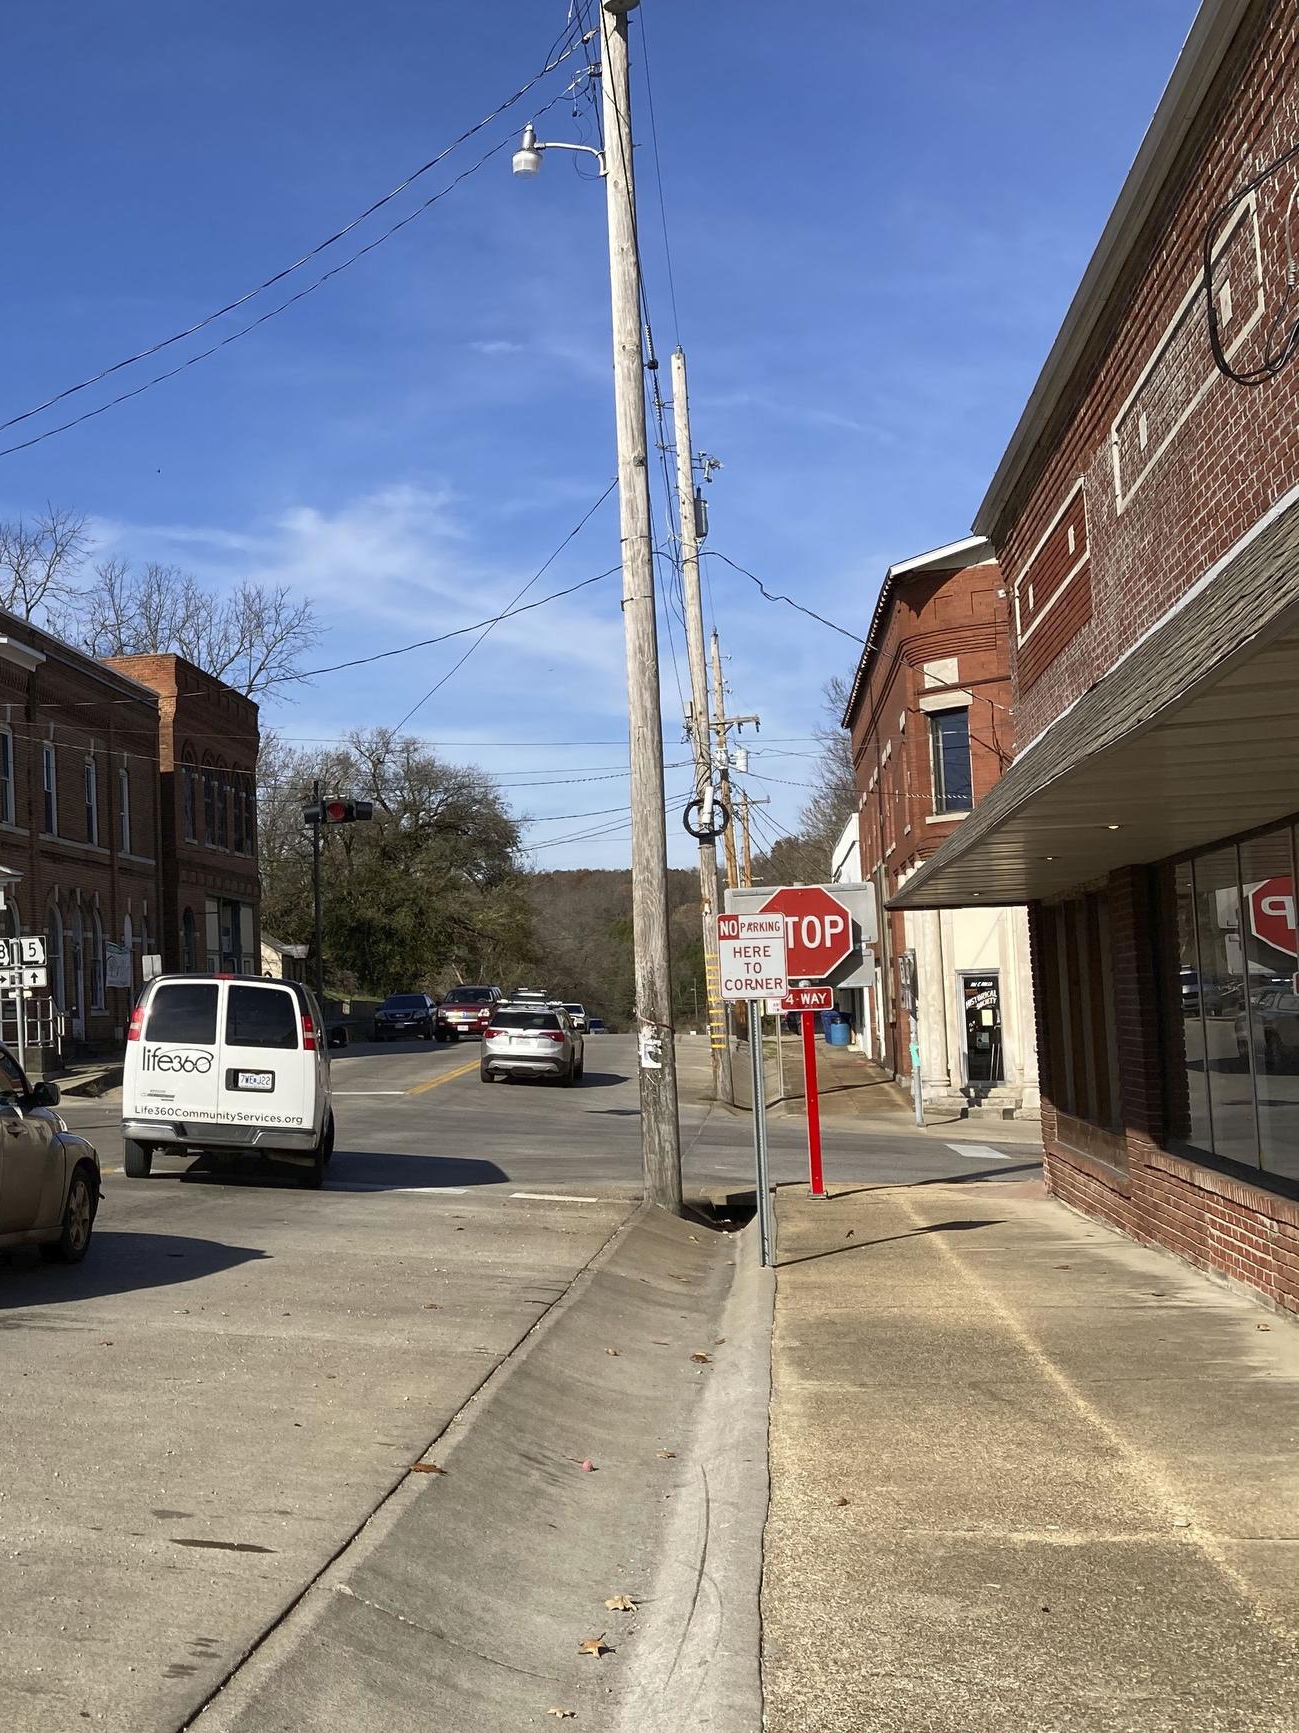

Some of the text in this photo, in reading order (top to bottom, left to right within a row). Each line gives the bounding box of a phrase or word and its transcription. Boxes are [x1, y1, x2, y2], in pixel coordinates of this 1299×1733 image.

[720, 920, 780, 936] NO PARKING
[785, 915, 844, 949] TOP
[28, 942, 37, 957] 5
[733, 946, 772, 958] HERE
[744, 962, 762, 974] TO
[724, 978, 783, 991] CORNER
[786, 992, 828, 1005] 4-WAY
[966, 989, 998, 1010] HISTORICAL
[142, 1046, 214, 1073] life360
[134, 1105, 303, 1125] Life360CommunityServices.org
